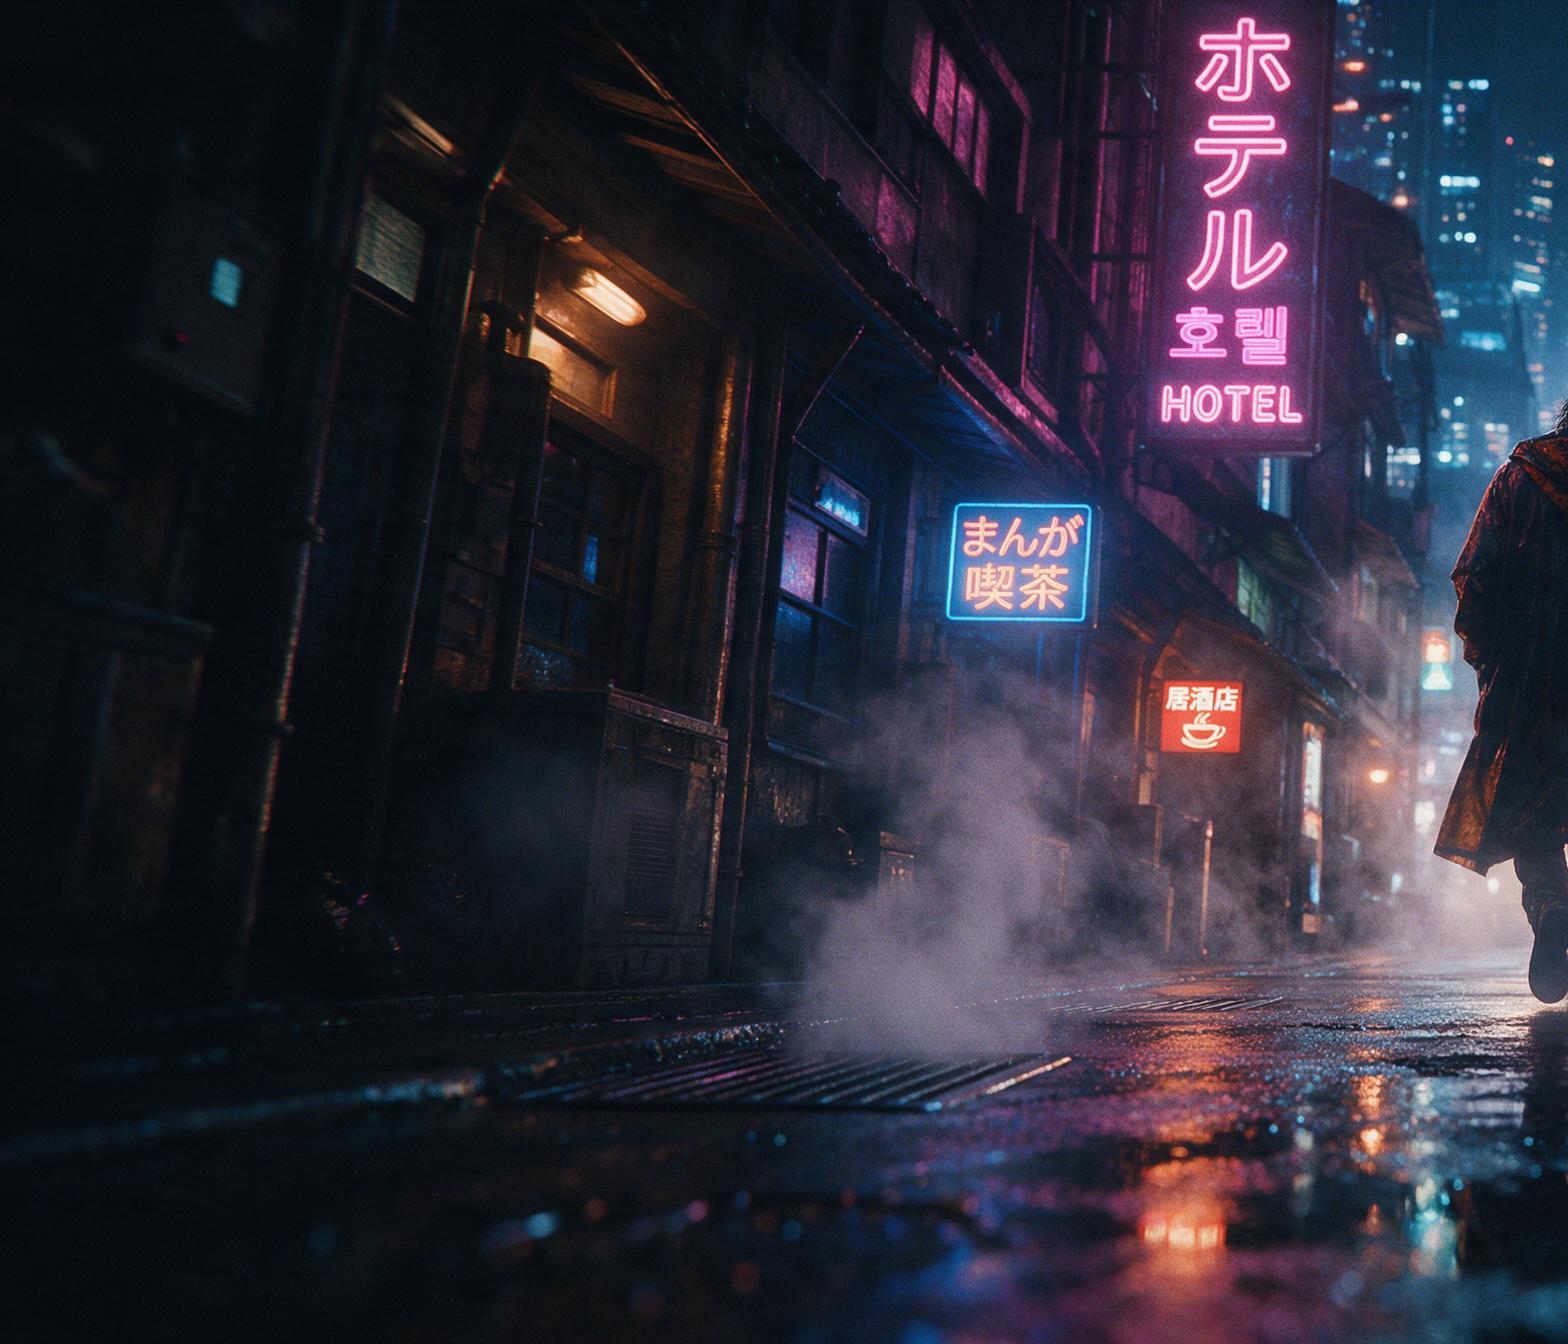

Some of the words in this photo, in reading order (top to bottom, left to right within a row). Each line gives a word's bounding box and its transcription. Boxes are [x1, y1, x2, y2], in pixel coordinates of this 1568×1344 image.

[1187, 17, 1291, 290] ホテル
[1161, 384, 1302, 424] HOTEL
[963, 514, 1084, 557] まんが
[965, 562, 1069, 611] 喫茶
[1165, 686, 1240, 712] 居酒店
